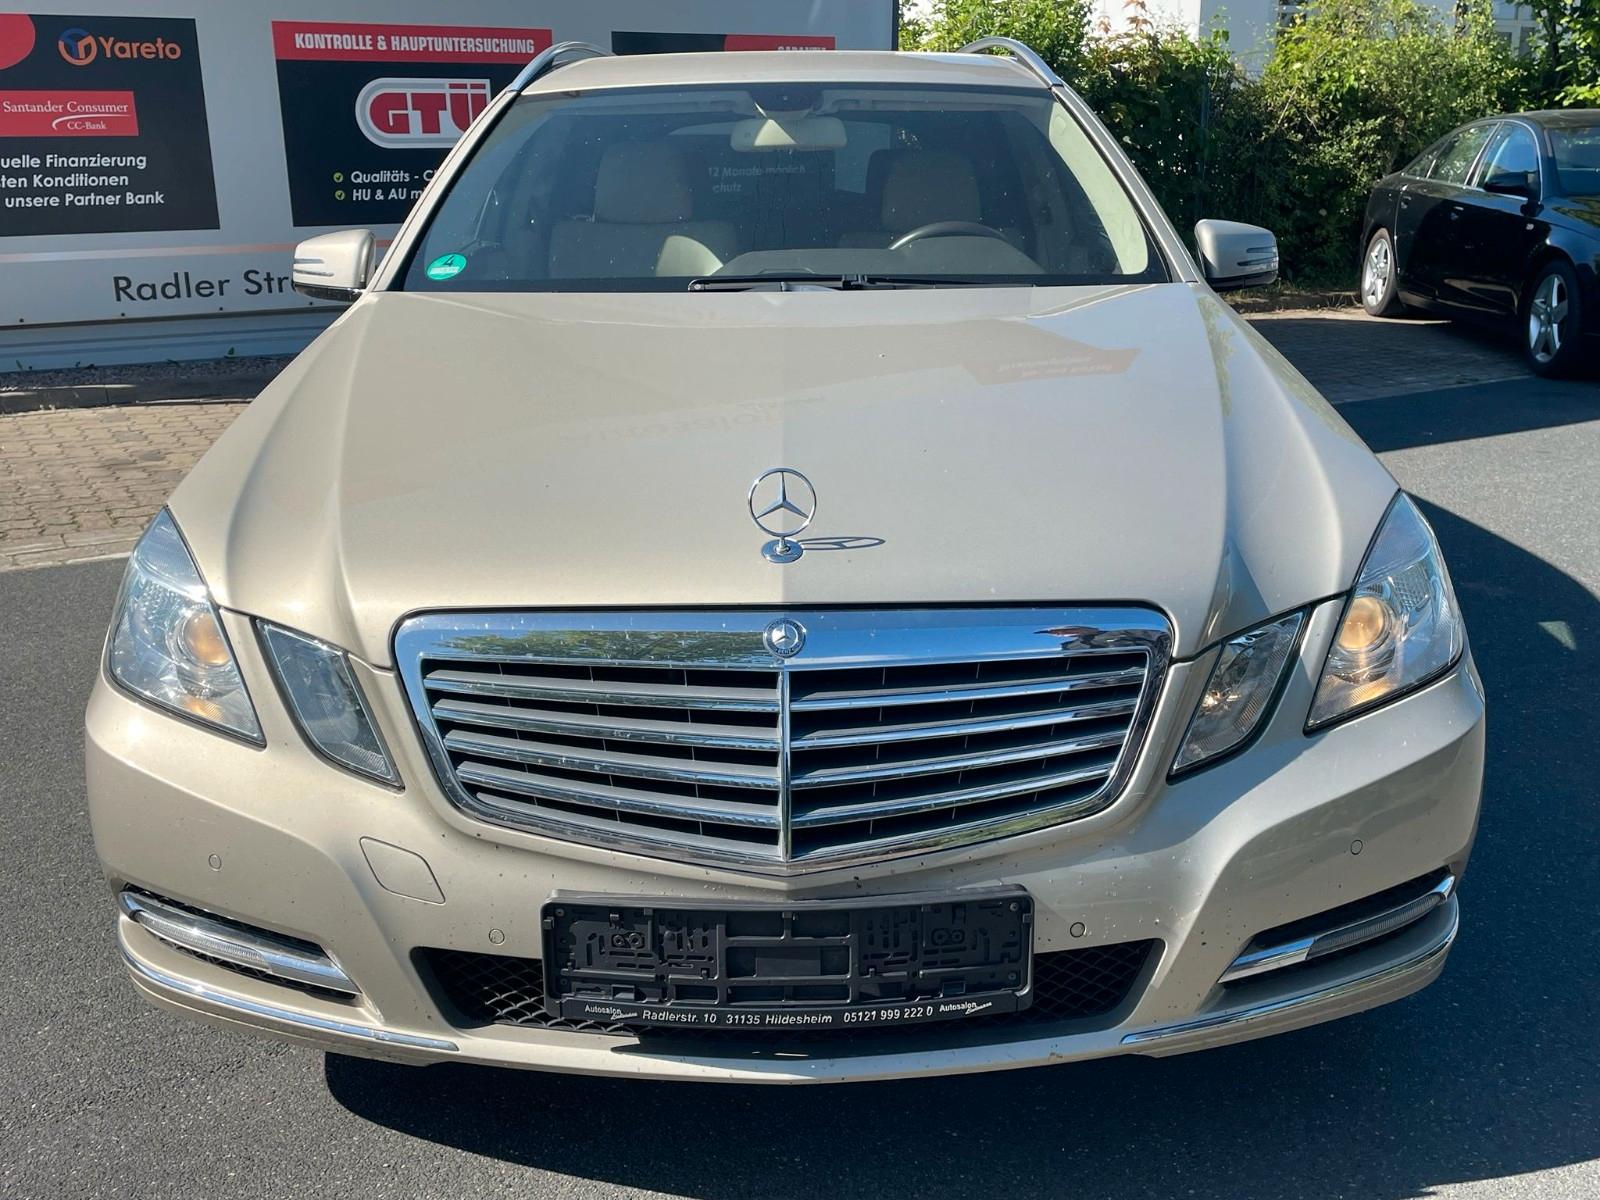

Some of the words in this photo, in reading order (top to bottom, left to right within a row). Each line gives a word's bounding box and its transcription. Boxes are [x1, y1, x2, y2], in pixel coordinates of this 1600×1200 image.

[99, 36, 182, 60] Yareto
[294, 32, 374, 50] KONTROLLE
[377, 35, 387, 50] &
[391, 36, 535, 54] HAUPTUNTERSUCHUNG
[2, 100, 64, 113] Santander
[66, 101, 129, 113] Consumer
[369, 82, 488, 135] GTÜ
[66, 121, 107, 130] CC-Bank
[45, 153, 147, 170] Finanzierung
[32, 173, 129, 188] Konditionen
[350, 170, 411, 184] Qualitäts
[423, 169, 437, 182] C
[4, 196, 60, 208] unsere
[64, 192, 121, 206] Partner
[125, 190, 165, 205] Bank
[352, 188, 372, 201] HU
[374, 188, 385, 201] &
[387, 187, 407, 200] AU
[410, 187, 425, 200] m
[442, 254, 455, 267] 4
[112, 271, 231, 302] Radler
[243, 269, 297, 295] Str
[584, 1004, 622, 1015] Autosalon
[939, 1001, 977, 1013] Autosalon
[642, 1009, 699, 1023] Radlerstr.
[703, 1013, 717, 1023] 10
[726, 1014, 761, 1025] 31135
[765, 1013, 833, 1025] Hildesheim
[843, 1010, 877, 1023] 05121
[880, 1009, 901, 1020] 999
[903, 1007, 923, 1019] 222
[926, 1005, 934, 1017] 0
